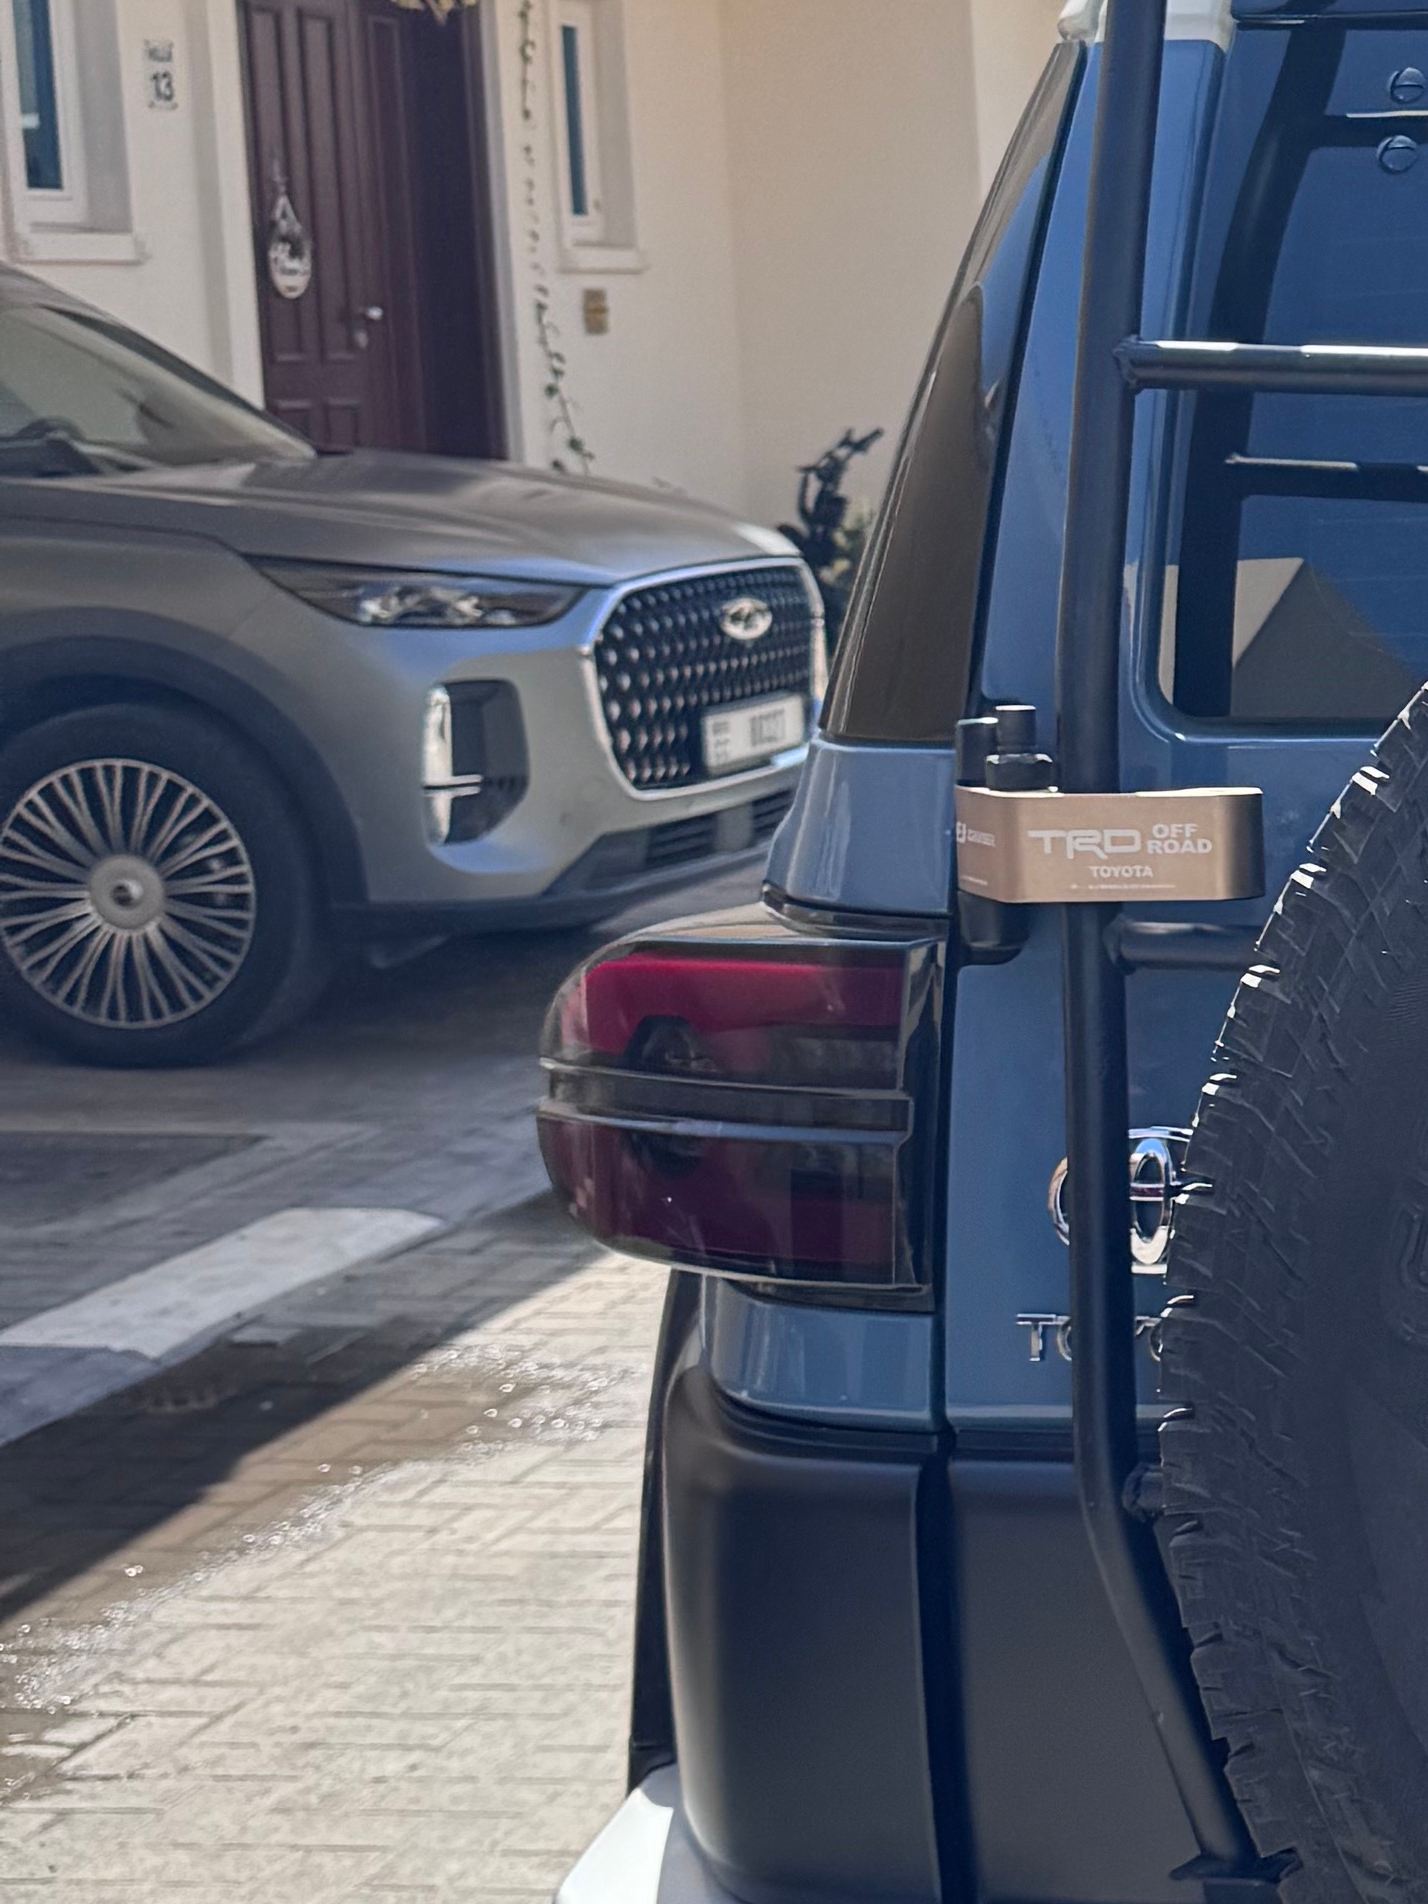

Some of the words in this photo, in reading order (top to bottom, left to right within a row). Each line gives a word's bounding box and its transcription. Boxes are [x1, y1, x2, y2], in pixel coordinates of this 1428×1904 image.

[1152, 824, 1198, 839] OFF
[1027, 828, 1142, 860] TRD
[1147, 839, 1212, 855] ROAD
[1089, 864, 1154, 879] TOYOTA
